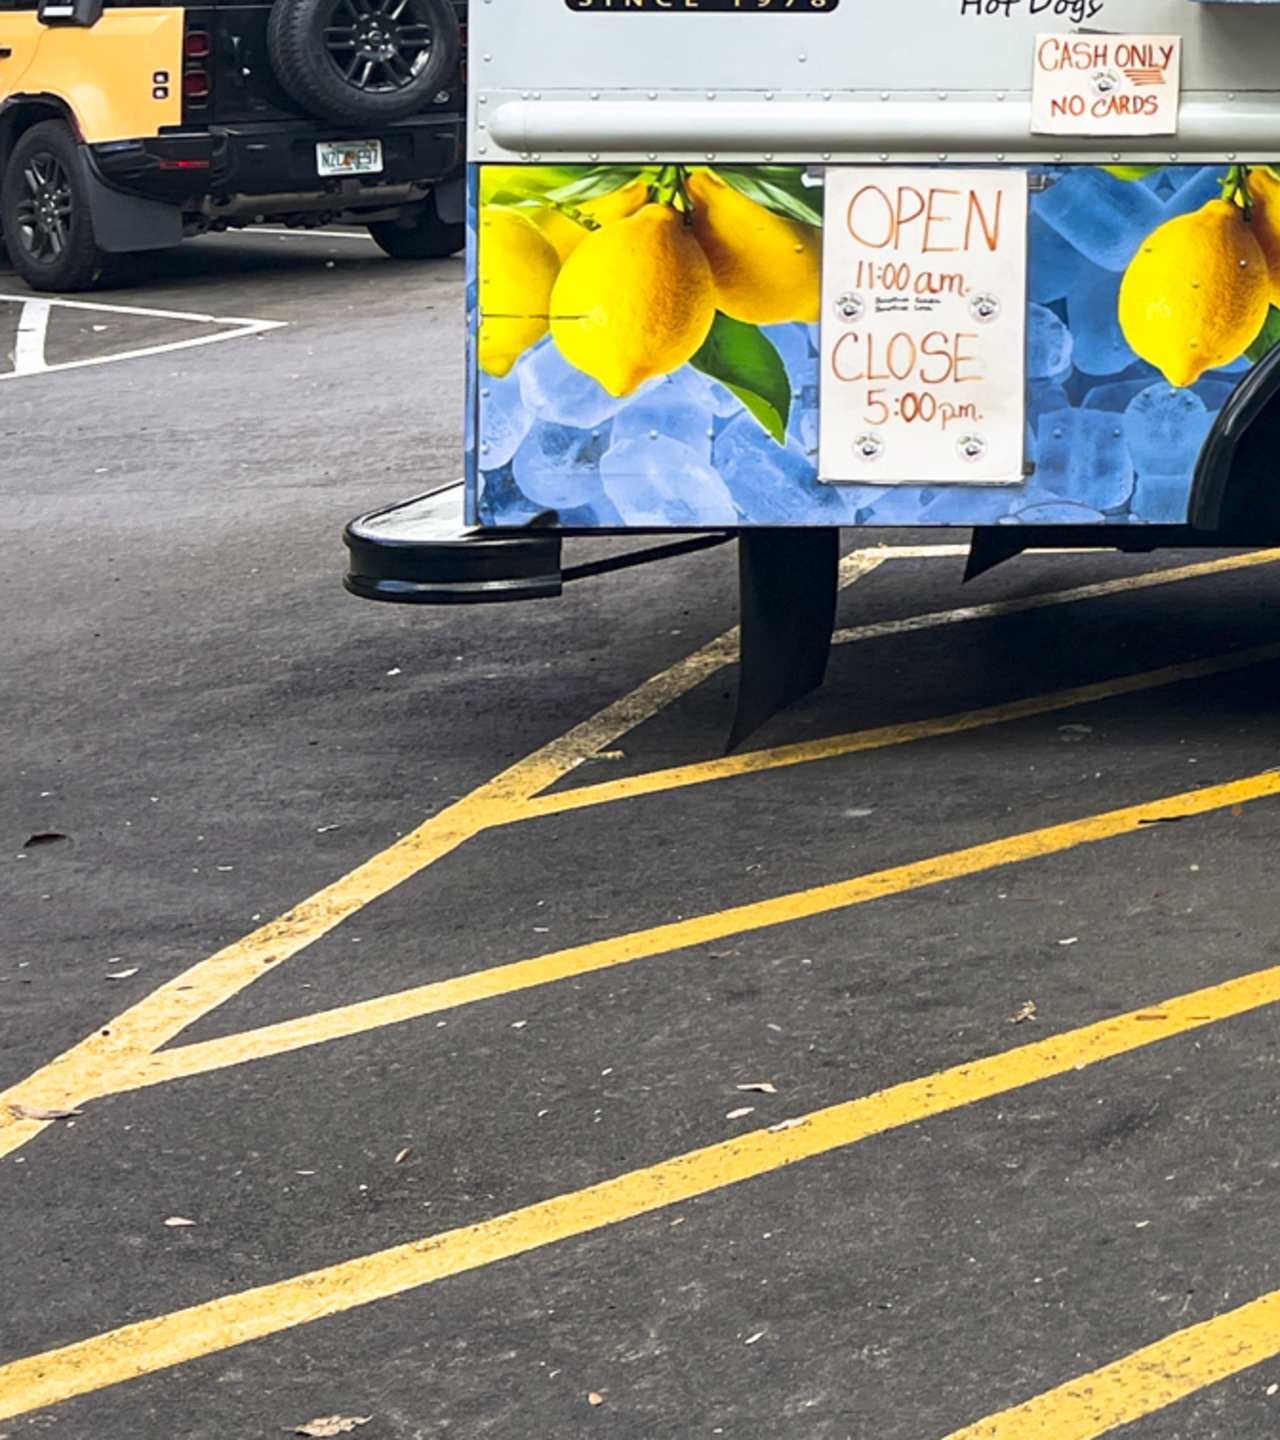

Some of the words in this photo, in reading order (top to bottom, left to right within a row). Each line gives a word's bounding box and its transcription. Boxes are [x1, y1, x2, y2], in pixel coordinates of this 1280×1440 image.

[1037, 38, 1107, 71] CASH
[1114, 43, 1173, 72] ONLY
[1050, 97, 1084, 117] NO
[1091, 94, 1159, 118] CARDS
[846, 185, 1002, 253] OPEN
[831, 331, 984, 384] CLOSE
